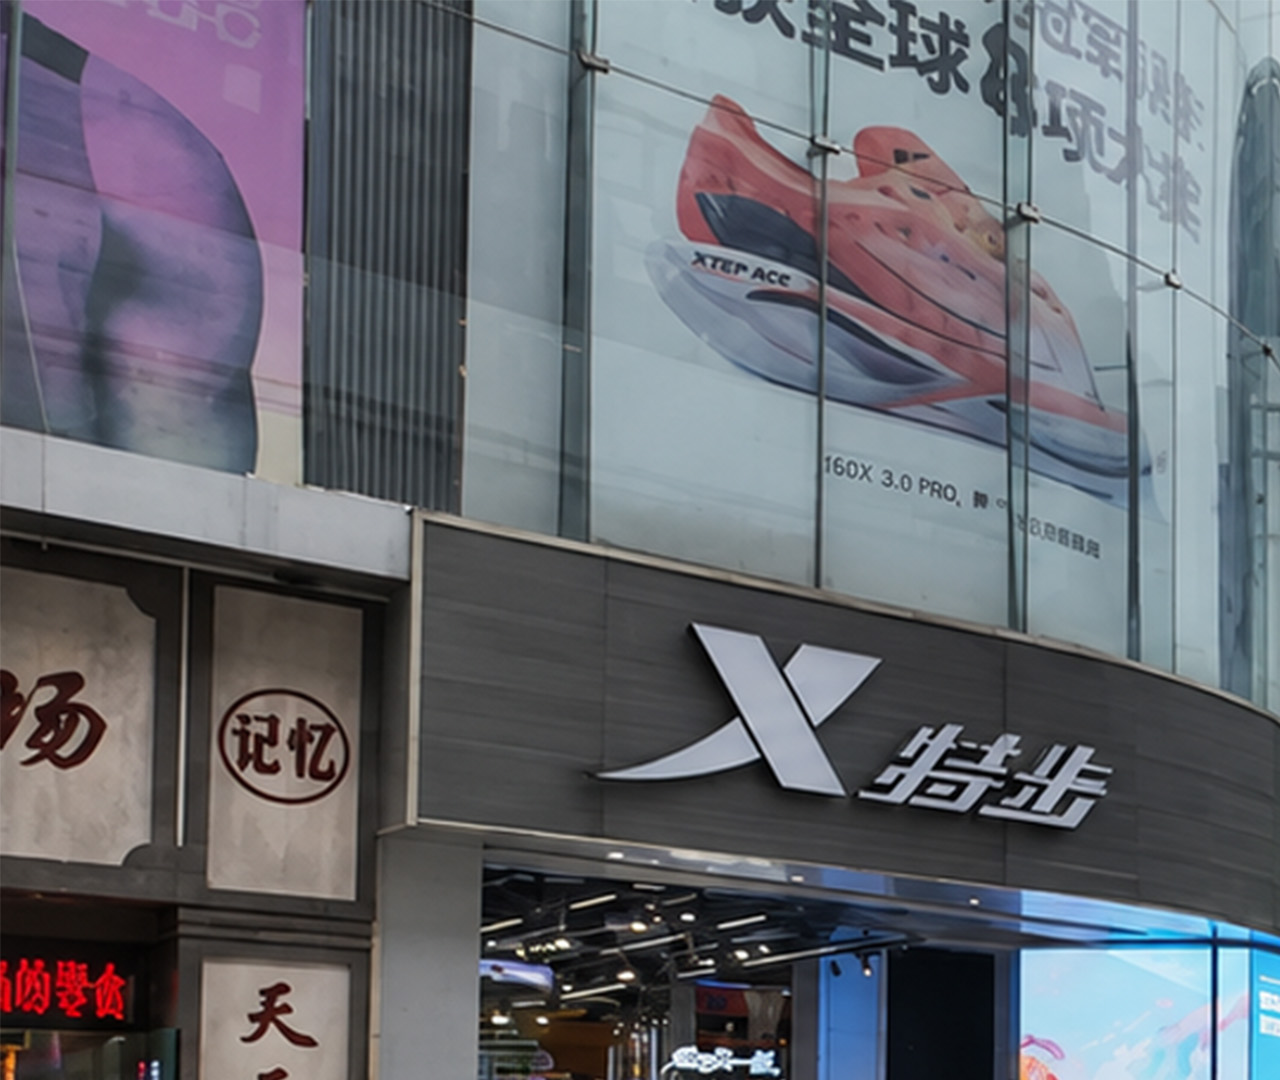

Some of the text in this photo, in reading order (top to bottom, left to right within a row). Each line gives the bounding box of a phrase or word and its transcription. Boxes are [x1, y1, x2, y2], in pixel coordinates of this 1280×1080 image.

[824, 455, 873, 483] 160X
[881, 469, 912, 493] 3.0
[231, 713, 337, 782] 记忆
[857, 723, 1115, 832] 特步
